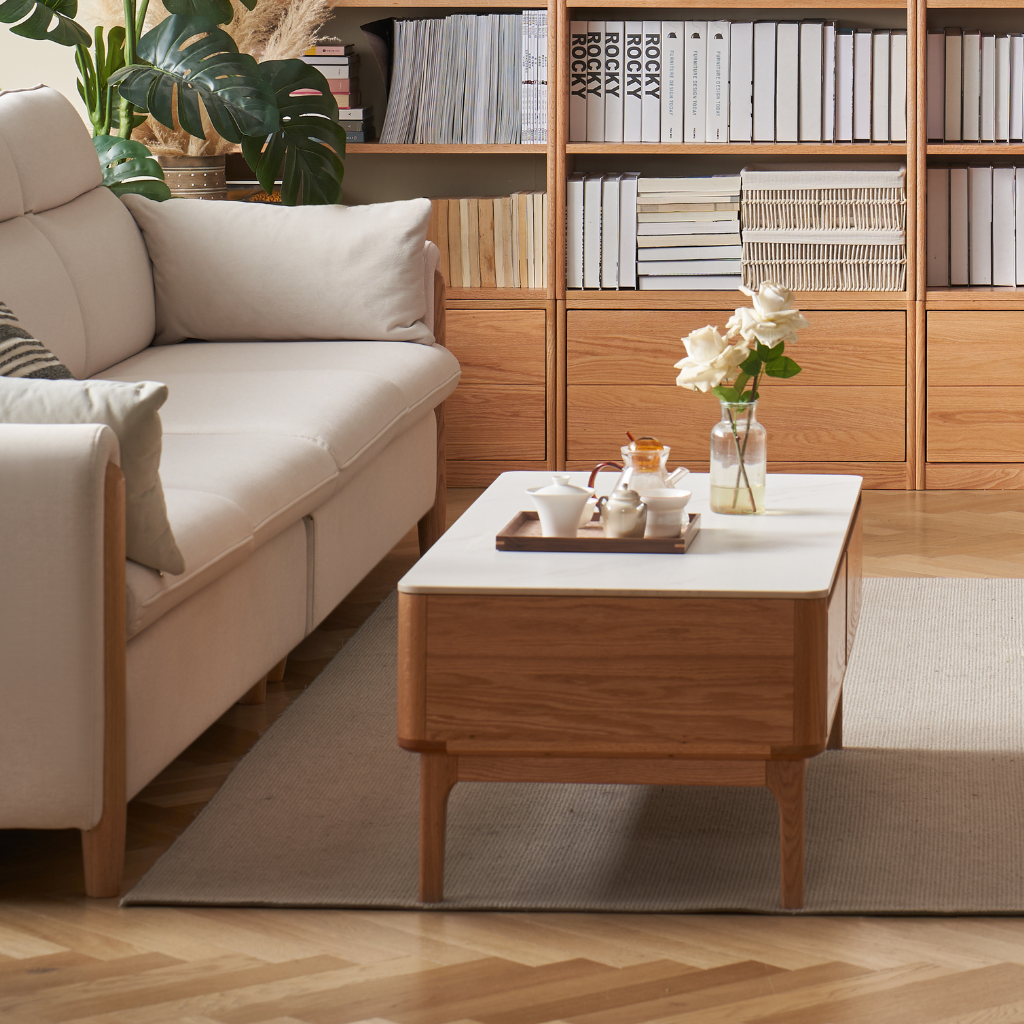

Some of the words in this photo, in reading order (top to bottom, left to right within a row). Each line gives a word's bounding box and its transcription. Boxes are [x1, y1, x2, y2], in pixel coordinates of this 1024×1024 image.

[571, 34, 586, 100] ROCKY
[587, 32, 601, 98] ROCKY
[605, 32, 620, 98] ROCKY
[627, 34, 642, 100] ROCKY
[645, 34, 660, 100] ROCKY
